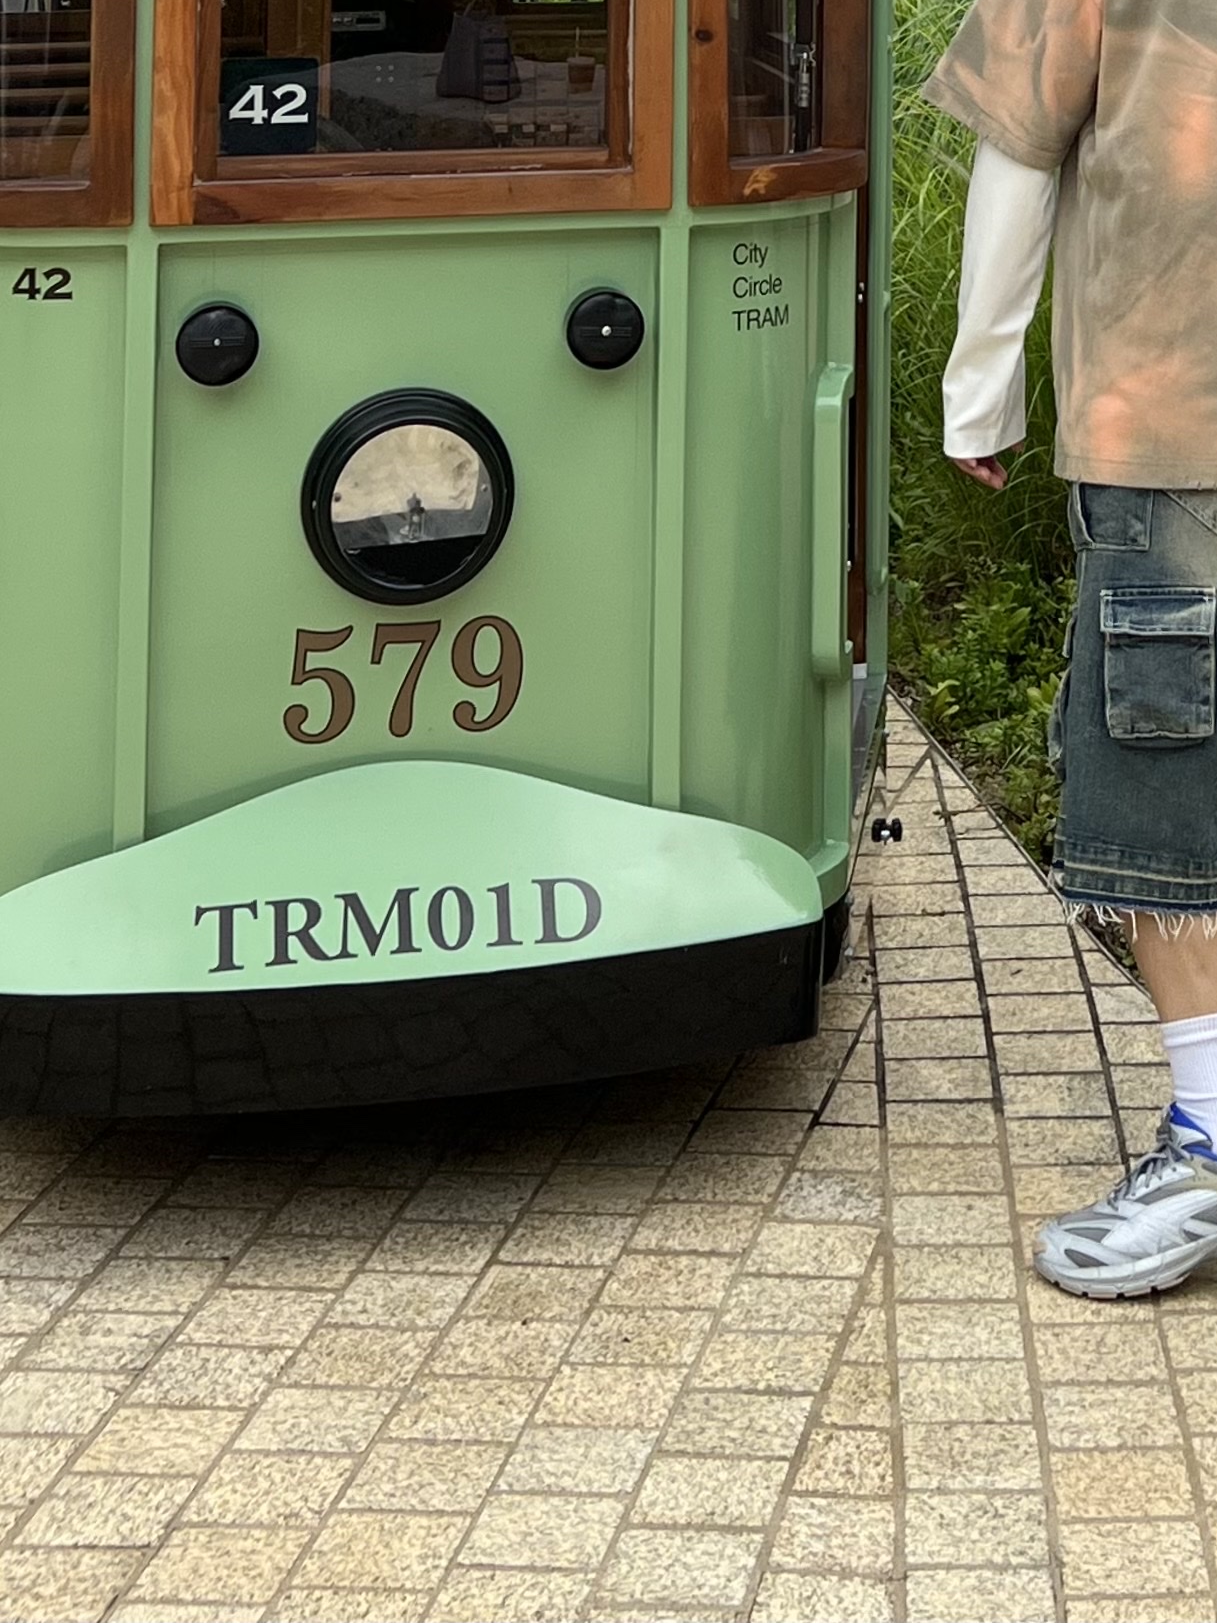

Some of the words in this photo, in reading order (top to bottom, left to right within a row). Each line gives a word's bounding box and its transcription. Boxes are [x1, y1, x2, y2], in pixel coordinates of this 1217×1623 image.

[229, 83, 309, 125] 42
[733, 242, 769, 269] City
[12, 267, 73, 301] 42
[733, 274, 783, 299] Circle
[732, 304, 789, 332] TRAM
[283, 614, 524, 745] 579
[195, 876, 603, 974] TRM01D
